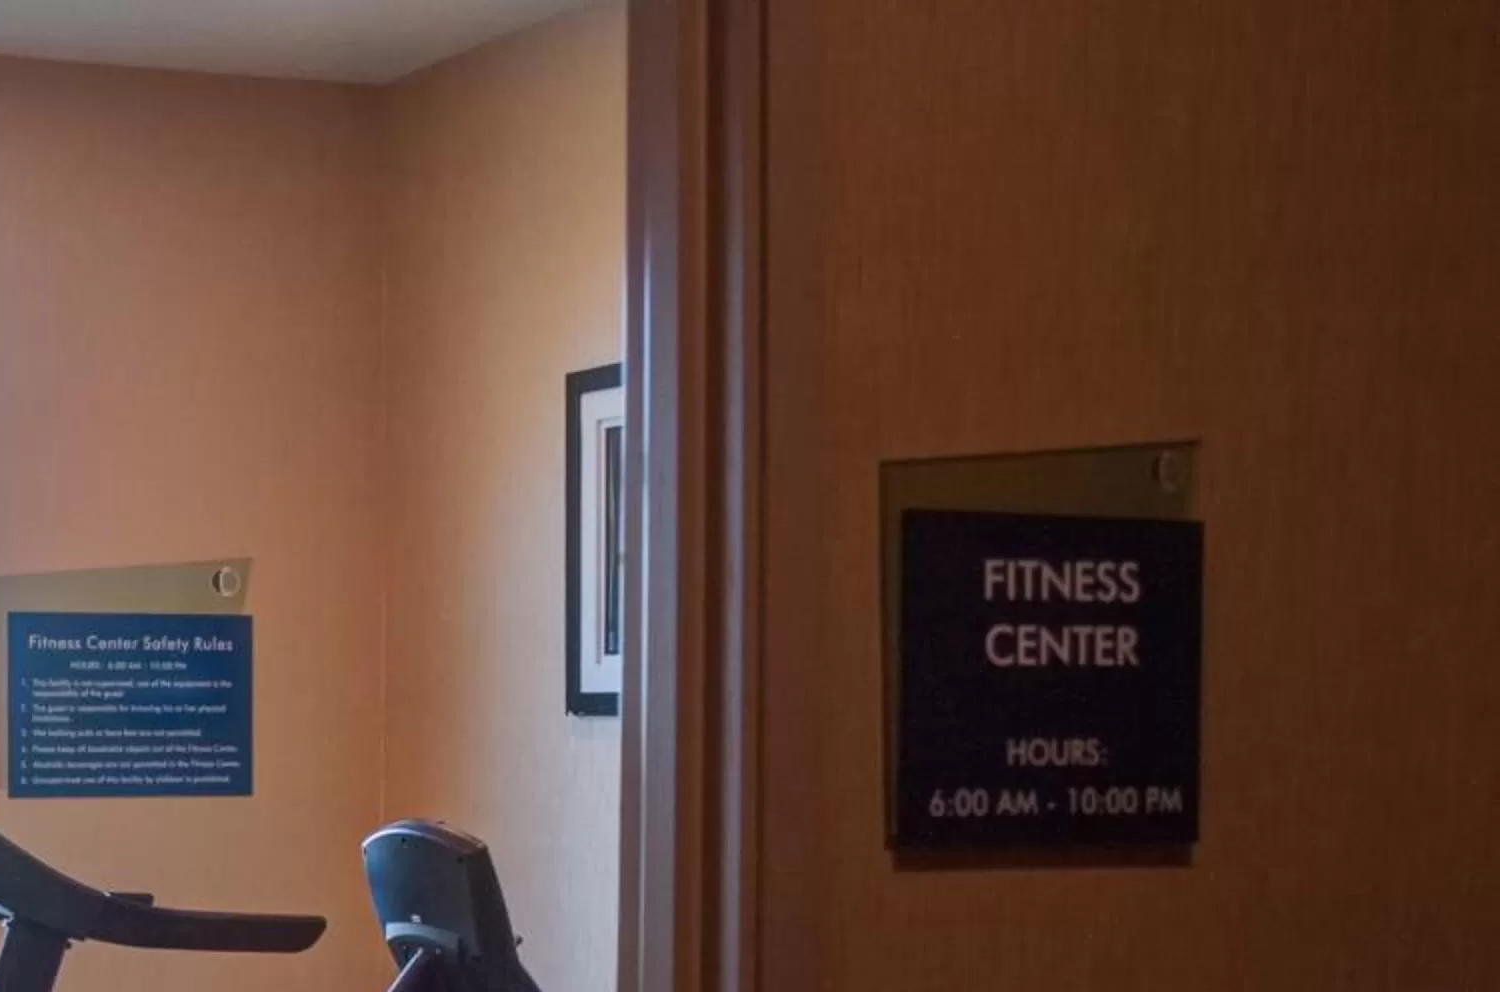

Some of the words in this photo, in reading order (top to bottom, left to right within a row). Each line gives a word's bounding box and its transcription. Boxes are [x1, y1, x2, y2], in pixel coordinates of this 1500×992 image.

[983, 559, 1141, 604] FITNESS
[28, 634, 81, 651] Fitness
[86, 634, 138, 651] Center
[143, 635, 189, 655] Safety
[194, 637, 233, 652] Rules
[985, 623, 1140, 666] CENTER
[1007, 738, 1108, 767] HOURS:
[928, 788, 988, 818] 6:00
[996, 788, 1039, 816] AM
[1067, 786, 1138, 815] 10:00
[1145, 787, 1183, 814] PM
